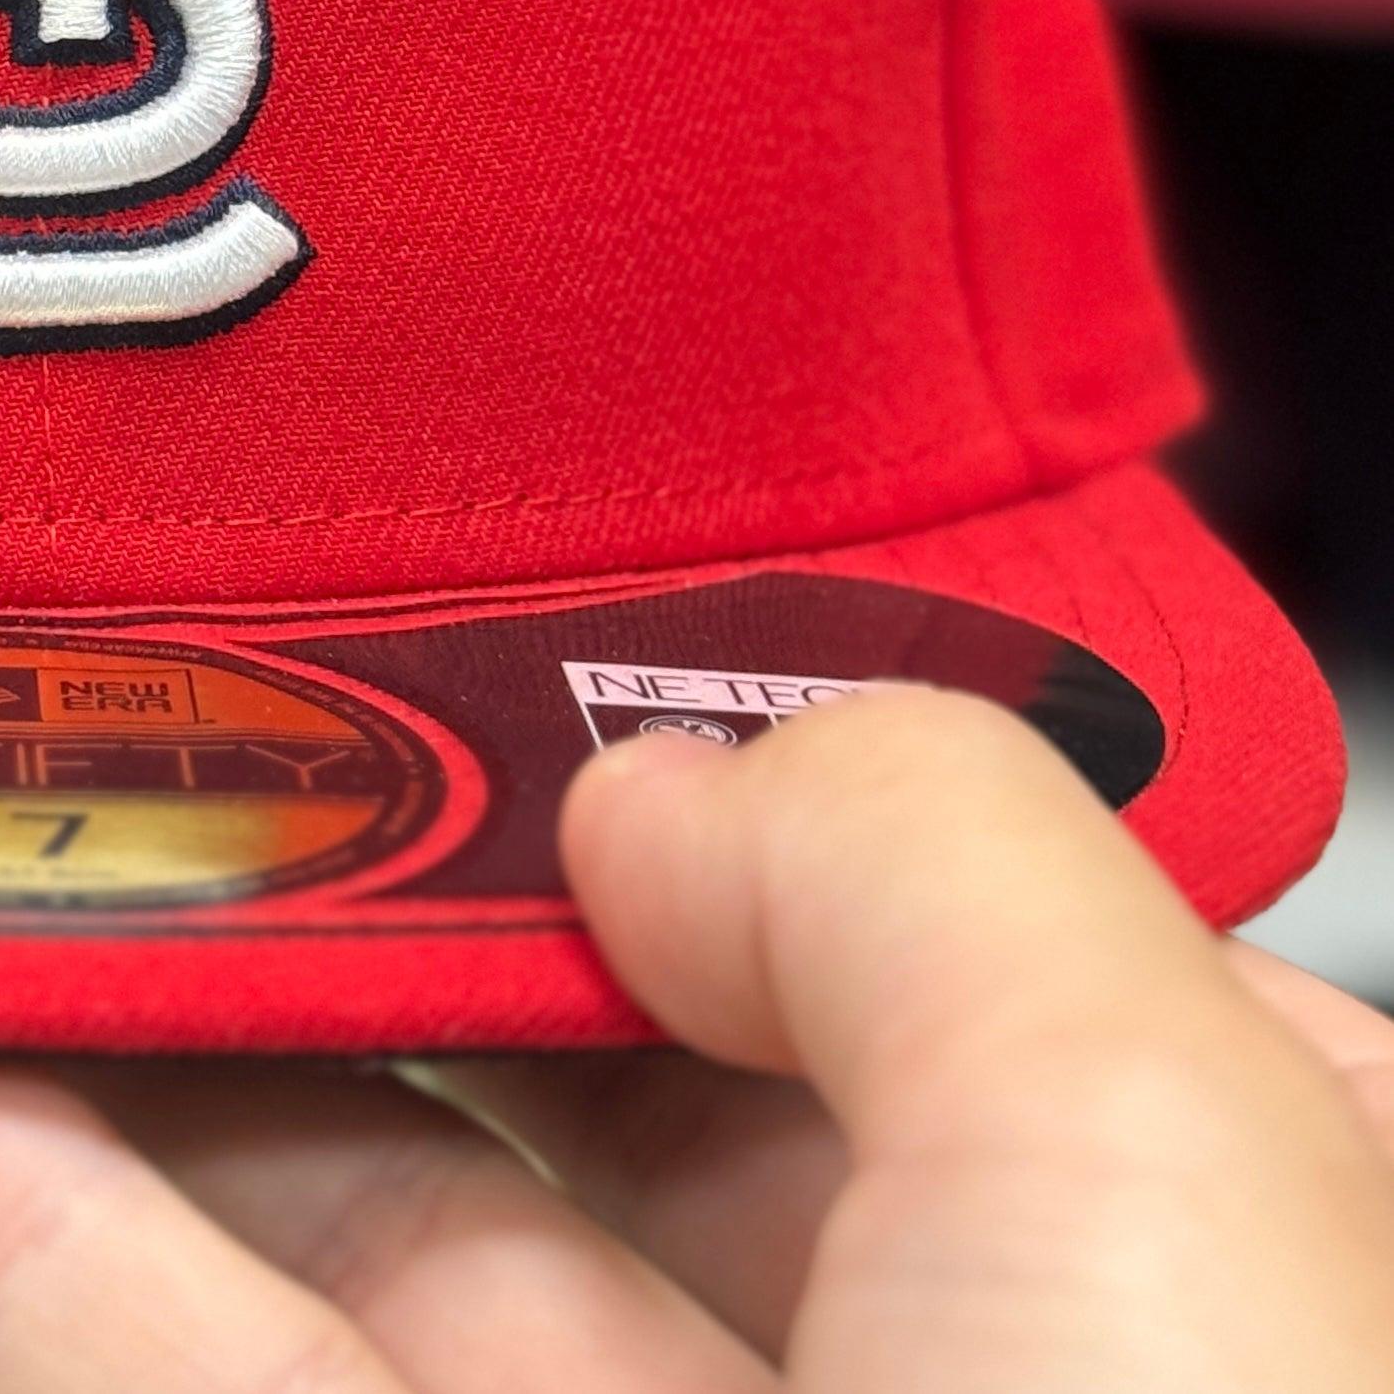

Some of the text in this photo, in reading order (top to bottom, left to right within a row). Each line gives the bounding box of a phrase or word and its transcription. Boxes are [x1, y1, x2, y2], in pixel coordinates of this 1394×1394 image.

[59, 680, 169, 697] NEW
[588, 670, 860, 710] NE TEC
[61, 695, 173, 713] ERA
[9, 811, 89, 859] 7
